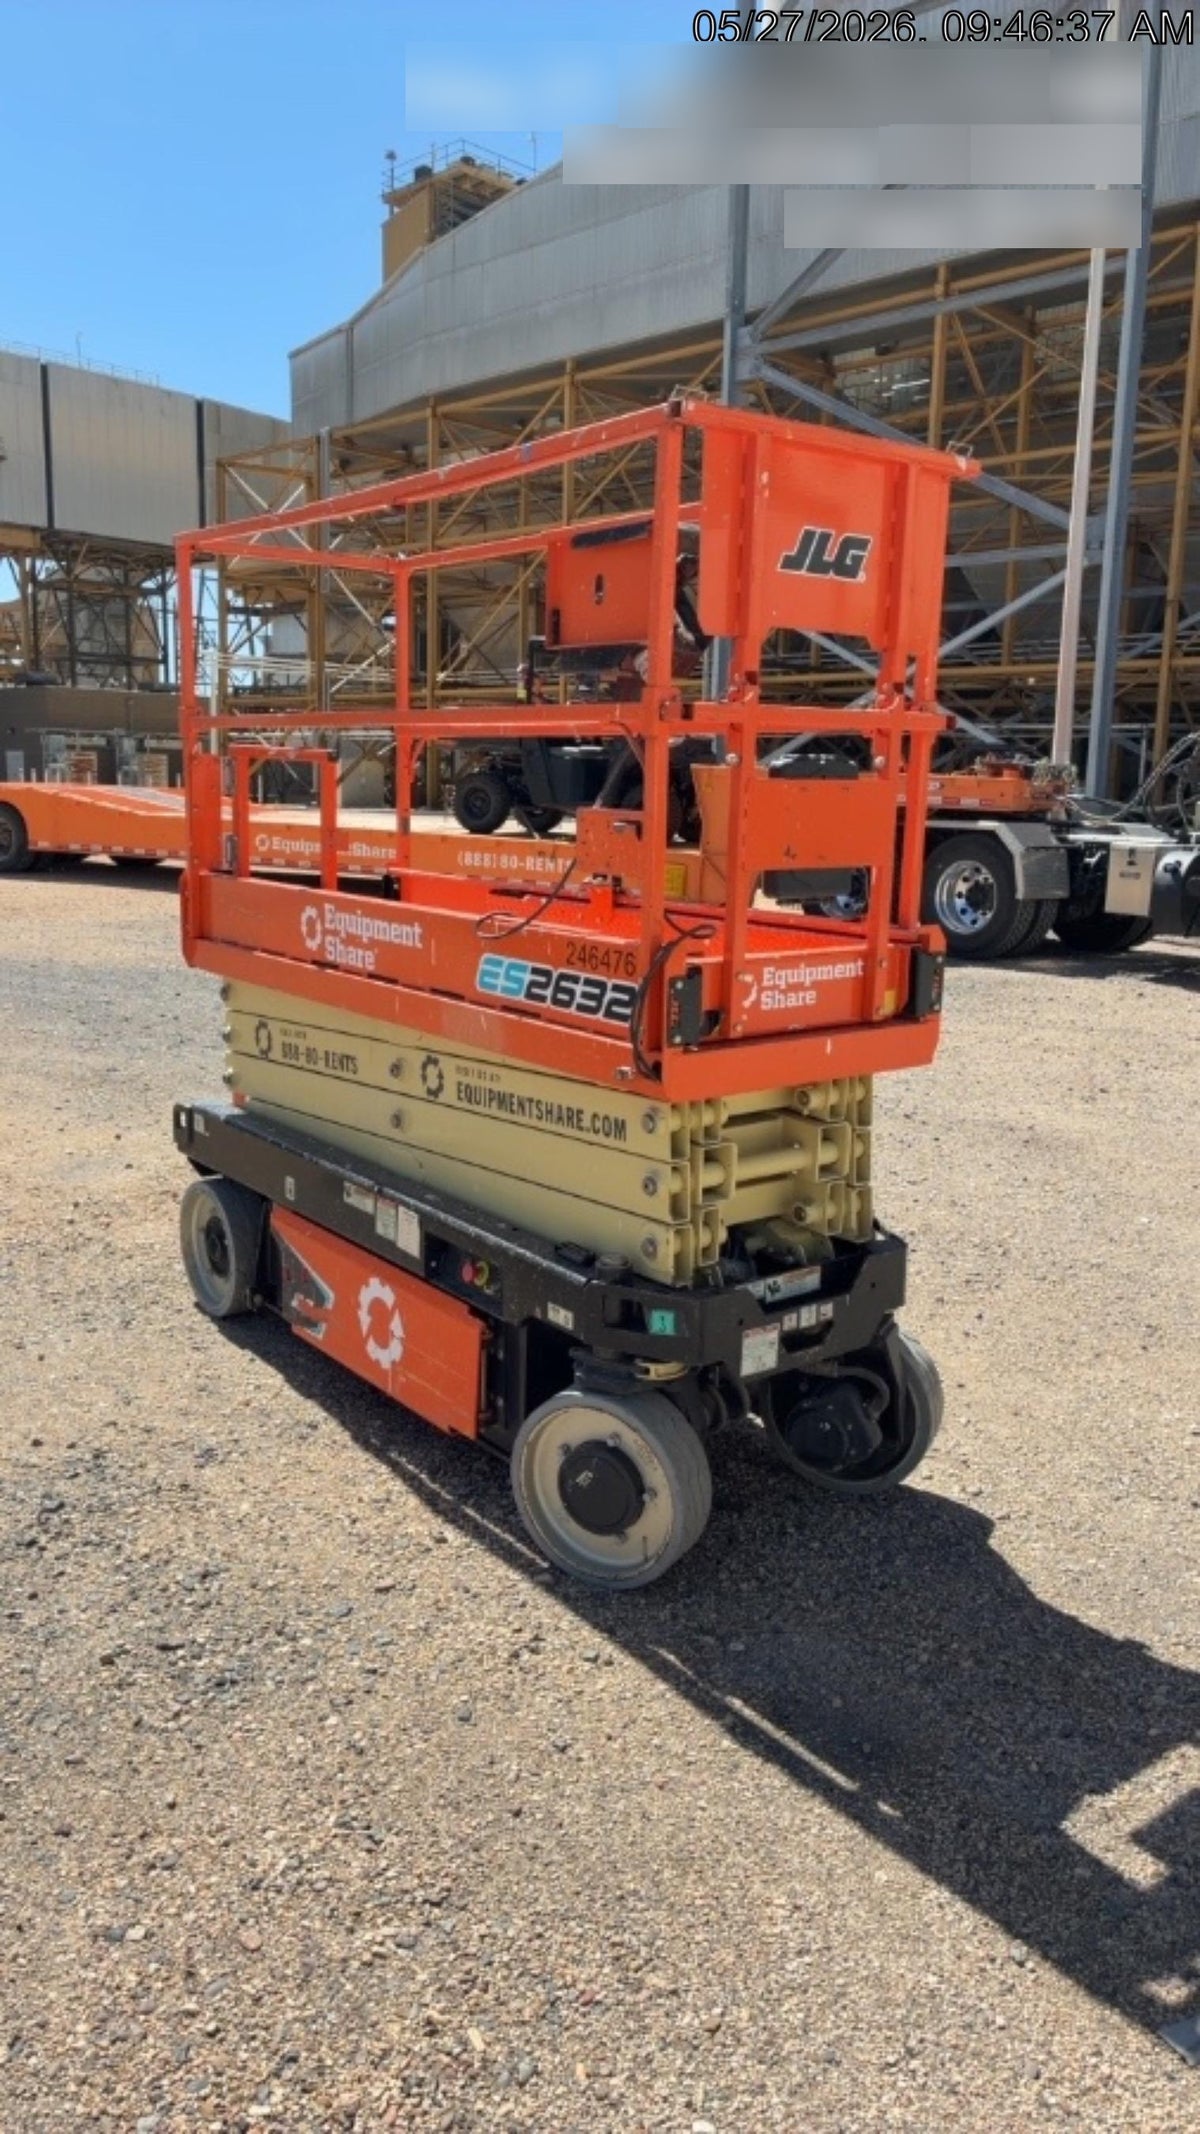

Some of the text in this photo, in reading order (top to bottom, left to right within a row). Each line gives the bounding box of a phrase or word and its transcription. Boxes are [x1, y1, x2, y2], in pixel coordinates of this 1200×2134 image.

[777, 525, 873, 582] JLG
[324, 903, 423, 948] Equipment
[325, 938, 376, 971] Share
[566, 941, 637, 977] 246476
[761, 957, 865, 988] Equipment
[476, 953, 640, 1025] ES2632
[760, 989, 817, 1011] Share
[456, 1081, 627, 1142] EQUIPMENTSHARE.COM
